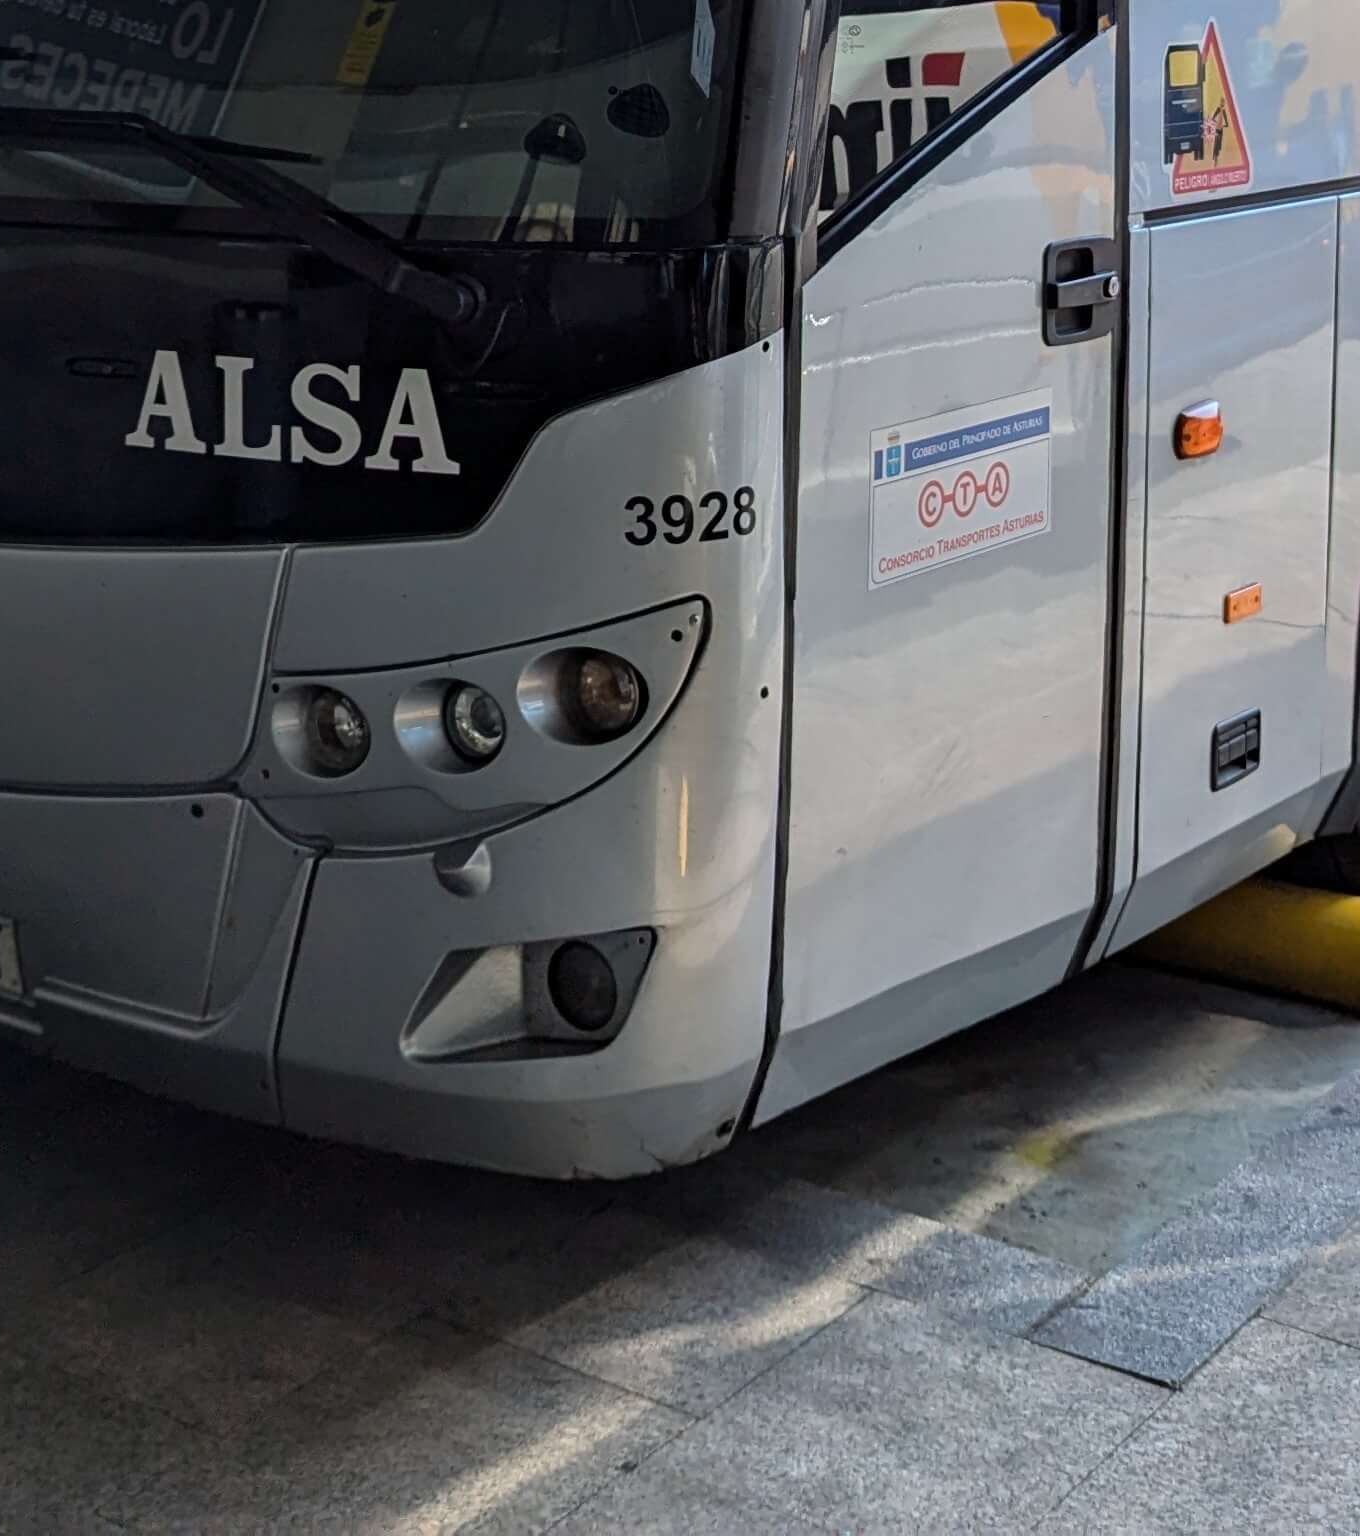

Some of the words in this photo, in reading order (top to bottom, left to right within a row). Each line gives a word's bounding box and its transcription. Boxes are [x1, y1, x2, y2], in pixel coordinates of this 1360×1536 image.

[124, 349, 461, 476] ALSA
[911, 440, 948, 460] GOBIERNO
[948, 438, 960, 449] DEL
[961, 426, 1001, 445] PRINCIPADO
[1003, 424, 1011, 435] DE
[1012, 415, 1044, 432] ASTURIAS
[623, 486, 758, 547] 3928
[878, 545, 936, 573] CONSORCIO
[936, 524, 1001, 555] TRANSPORTES
[1002, 510, 1045, 535] ASTURIAS
